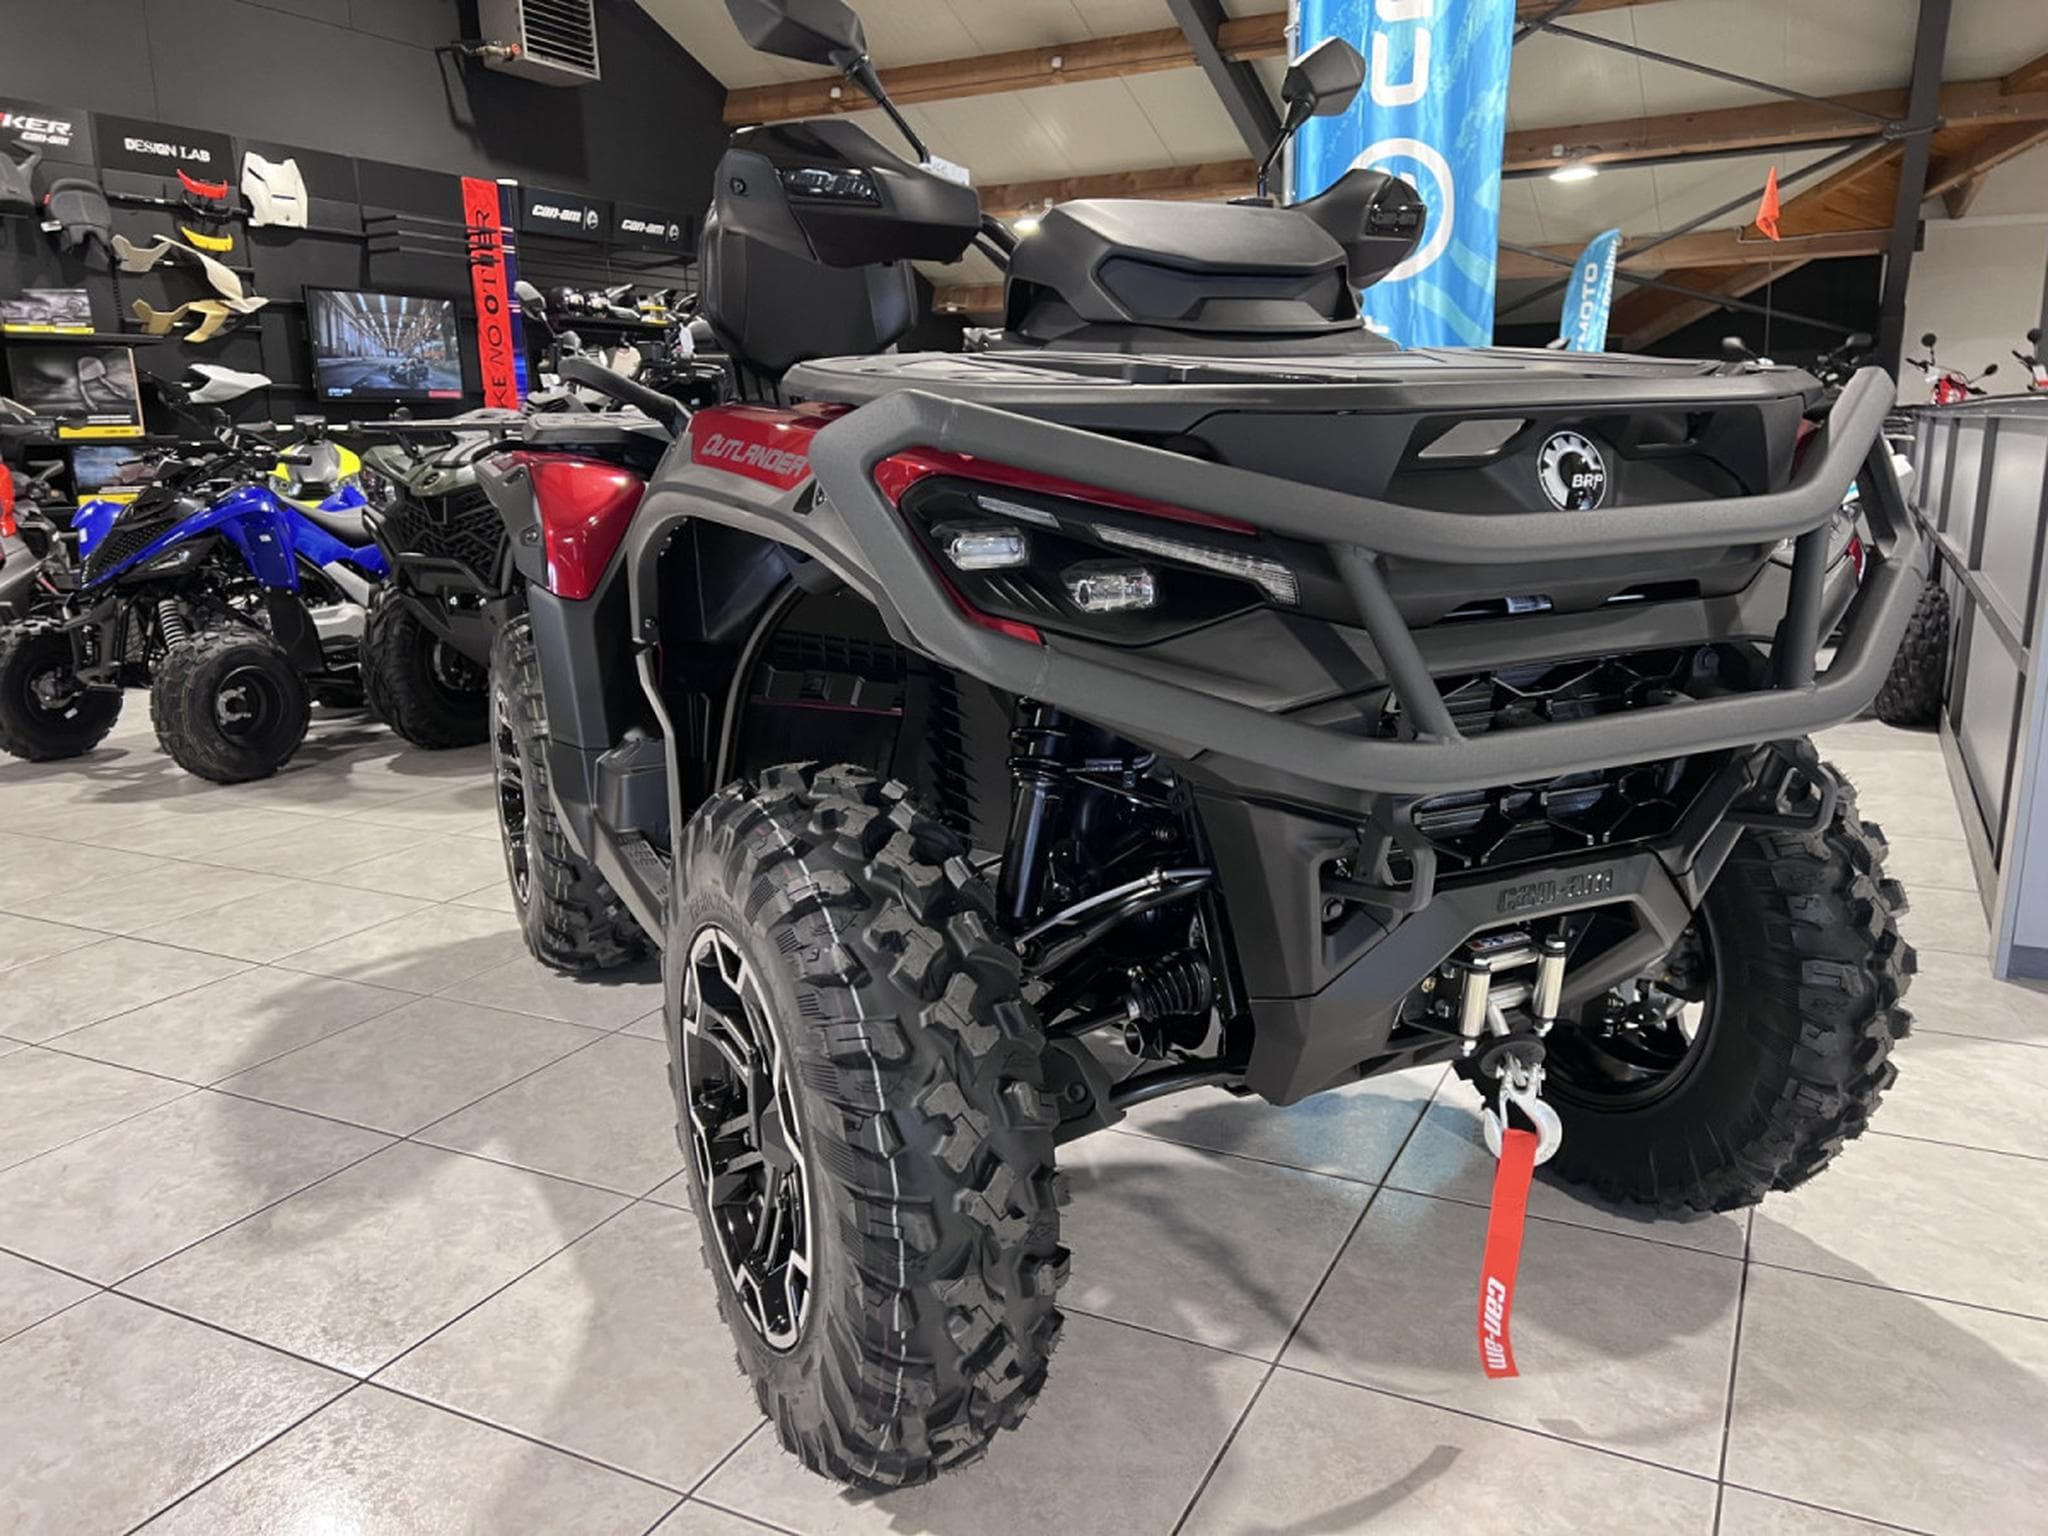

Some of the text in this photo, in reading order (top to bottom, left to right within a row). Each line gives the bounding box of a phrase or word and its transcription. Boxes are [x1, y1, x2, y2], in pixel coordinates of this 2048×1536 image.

[0, 112, 71, 136] KER
[124, 137, 211, 163] DESIGN LAB
[532, 204, 582, 223] can-am
[621, 219, 665, 236] can-am
[488, 324, 504, 366] NO
[701, 433, 809, 479] OUTLANDER
[1572, 473, 1604, 490] BRP
[1484, 1276, 1507, 1370] can-am
